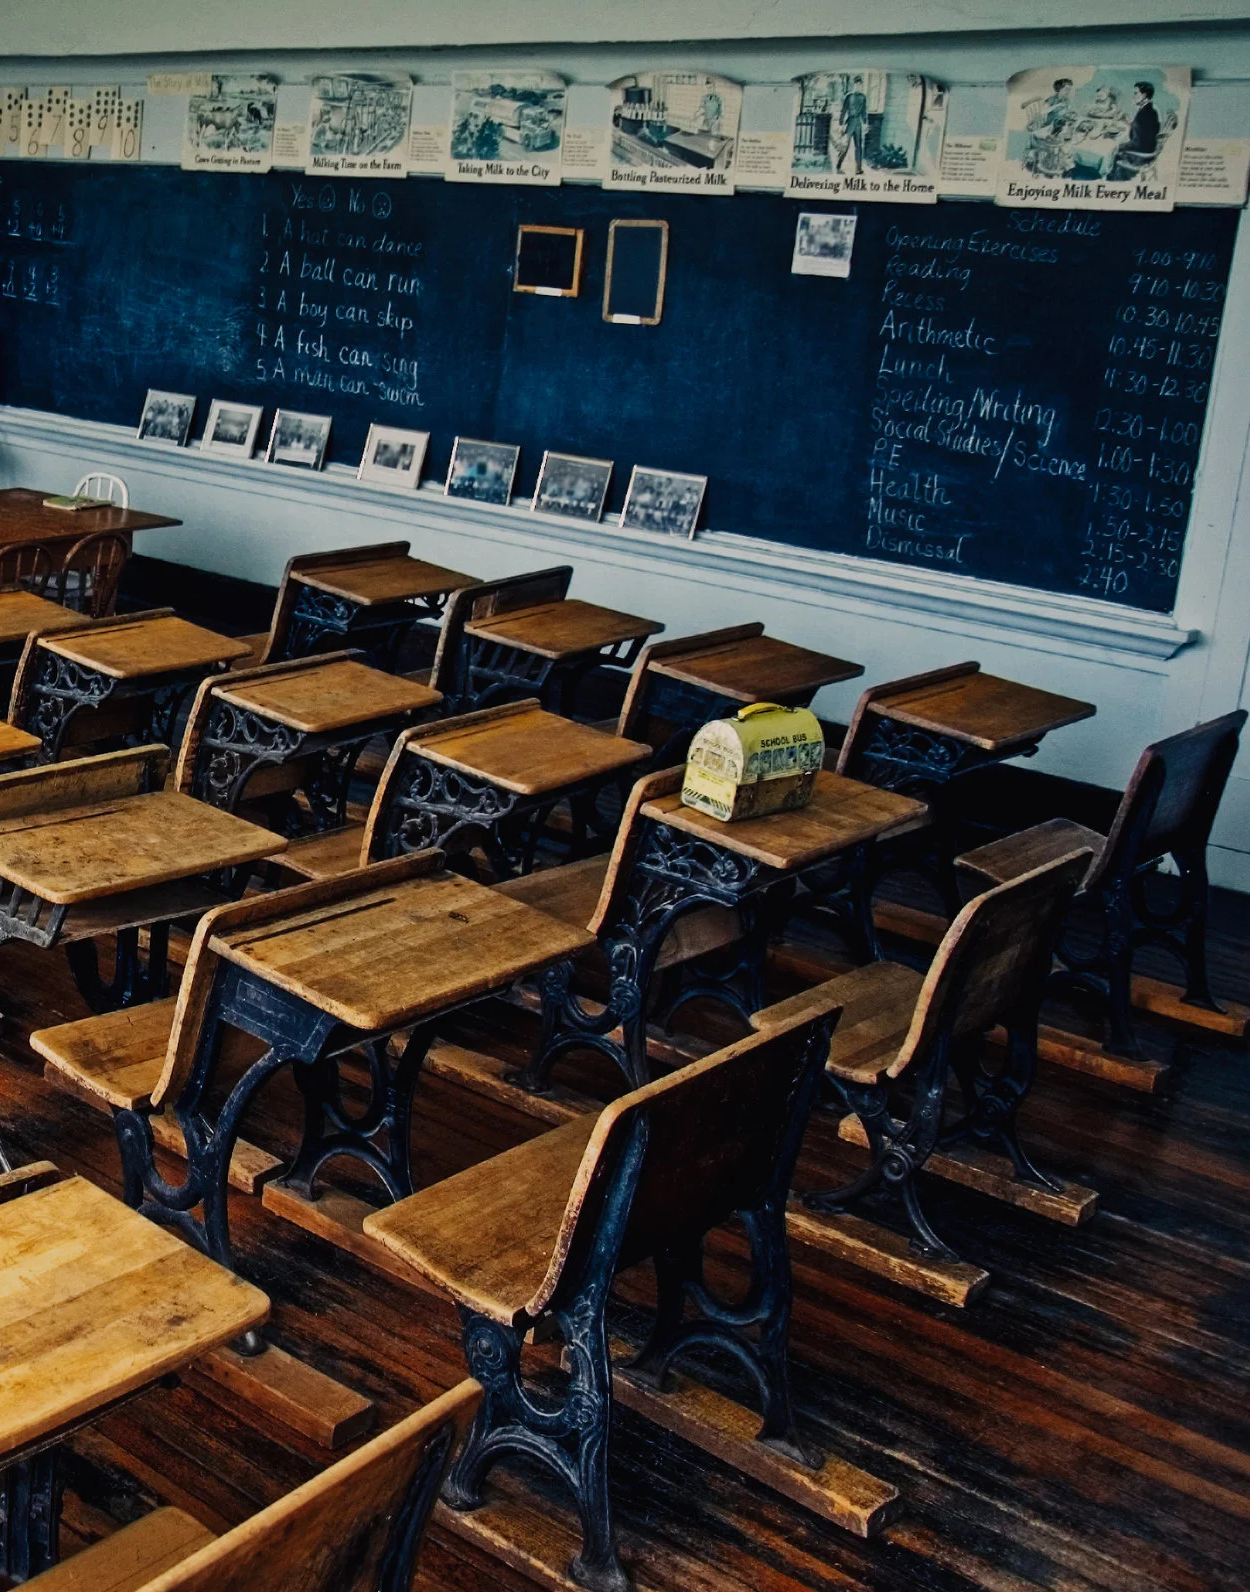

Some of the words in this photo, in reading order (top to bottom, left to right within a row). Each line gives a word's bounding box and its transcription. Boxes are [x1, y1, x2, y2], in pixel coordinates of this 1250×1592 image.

[457, 162, 483, 177] Taking
[485, 163, 504, 176] Milk
[506, 165, 515, 176] to
[516, 164, 529, 177] the
[531, 165, 551, 183] City
[611, 169, 647, 185] Bottling
[650, 171, 701, 185] Pasteurized
[704, 172, 727, 185] Milk
[790, 176, 840, 193] Delivering
[843, 178, 867, 191] Milk
[870, 180, 881, 192] to
[883, 179, 900, 192] the
[902, 179, 935, 193] Home
[1007, 183, 1060, 201] Enjoying
[1062, 184, 1092, 199] Milk
[1095, 186, 1130, 203] Every
[1133, 186, 1167, 201] Meal
[372, 232, 424, 258] dance
[886, 225, 964, 264] Opening
[966, 229, 1059, 264] Exercises
[279, 249, 291, 277] A
[300, 252, 336, 284] ball
[343, 267, 379, 291] can
[388, 273, 422, 296] run
[886, 254, 970, 292] Reading
[277, 289, 288, 313] A
[299, 291, 329, 328] boy
[336, 304, 370, 323] can
[376, 300, 414, 340] skip
[879, 309, 999, 356] Arithmetic
[256, 358, 268, 381] 5
[273, 356, 286, 380] A
[294, 365, 335, 393] man
[339, 375, 371, 395] can
[274, 324, 286, 351] A
[297, 329, 331, 363] fish
[339, 345, 374, 367] can
[381, 352, 419, 391] sing
[878, 343, 954, 384] Lunch
[871, 406, 932, 443] Social
[870, 467, 952, 505] Health
[867, 497, 926, 532] Music
[866, 525, 964, 563] Dismissal
[760, 736, 790, 750] SCHOOL
[792, 733, 807, 745] BUS
